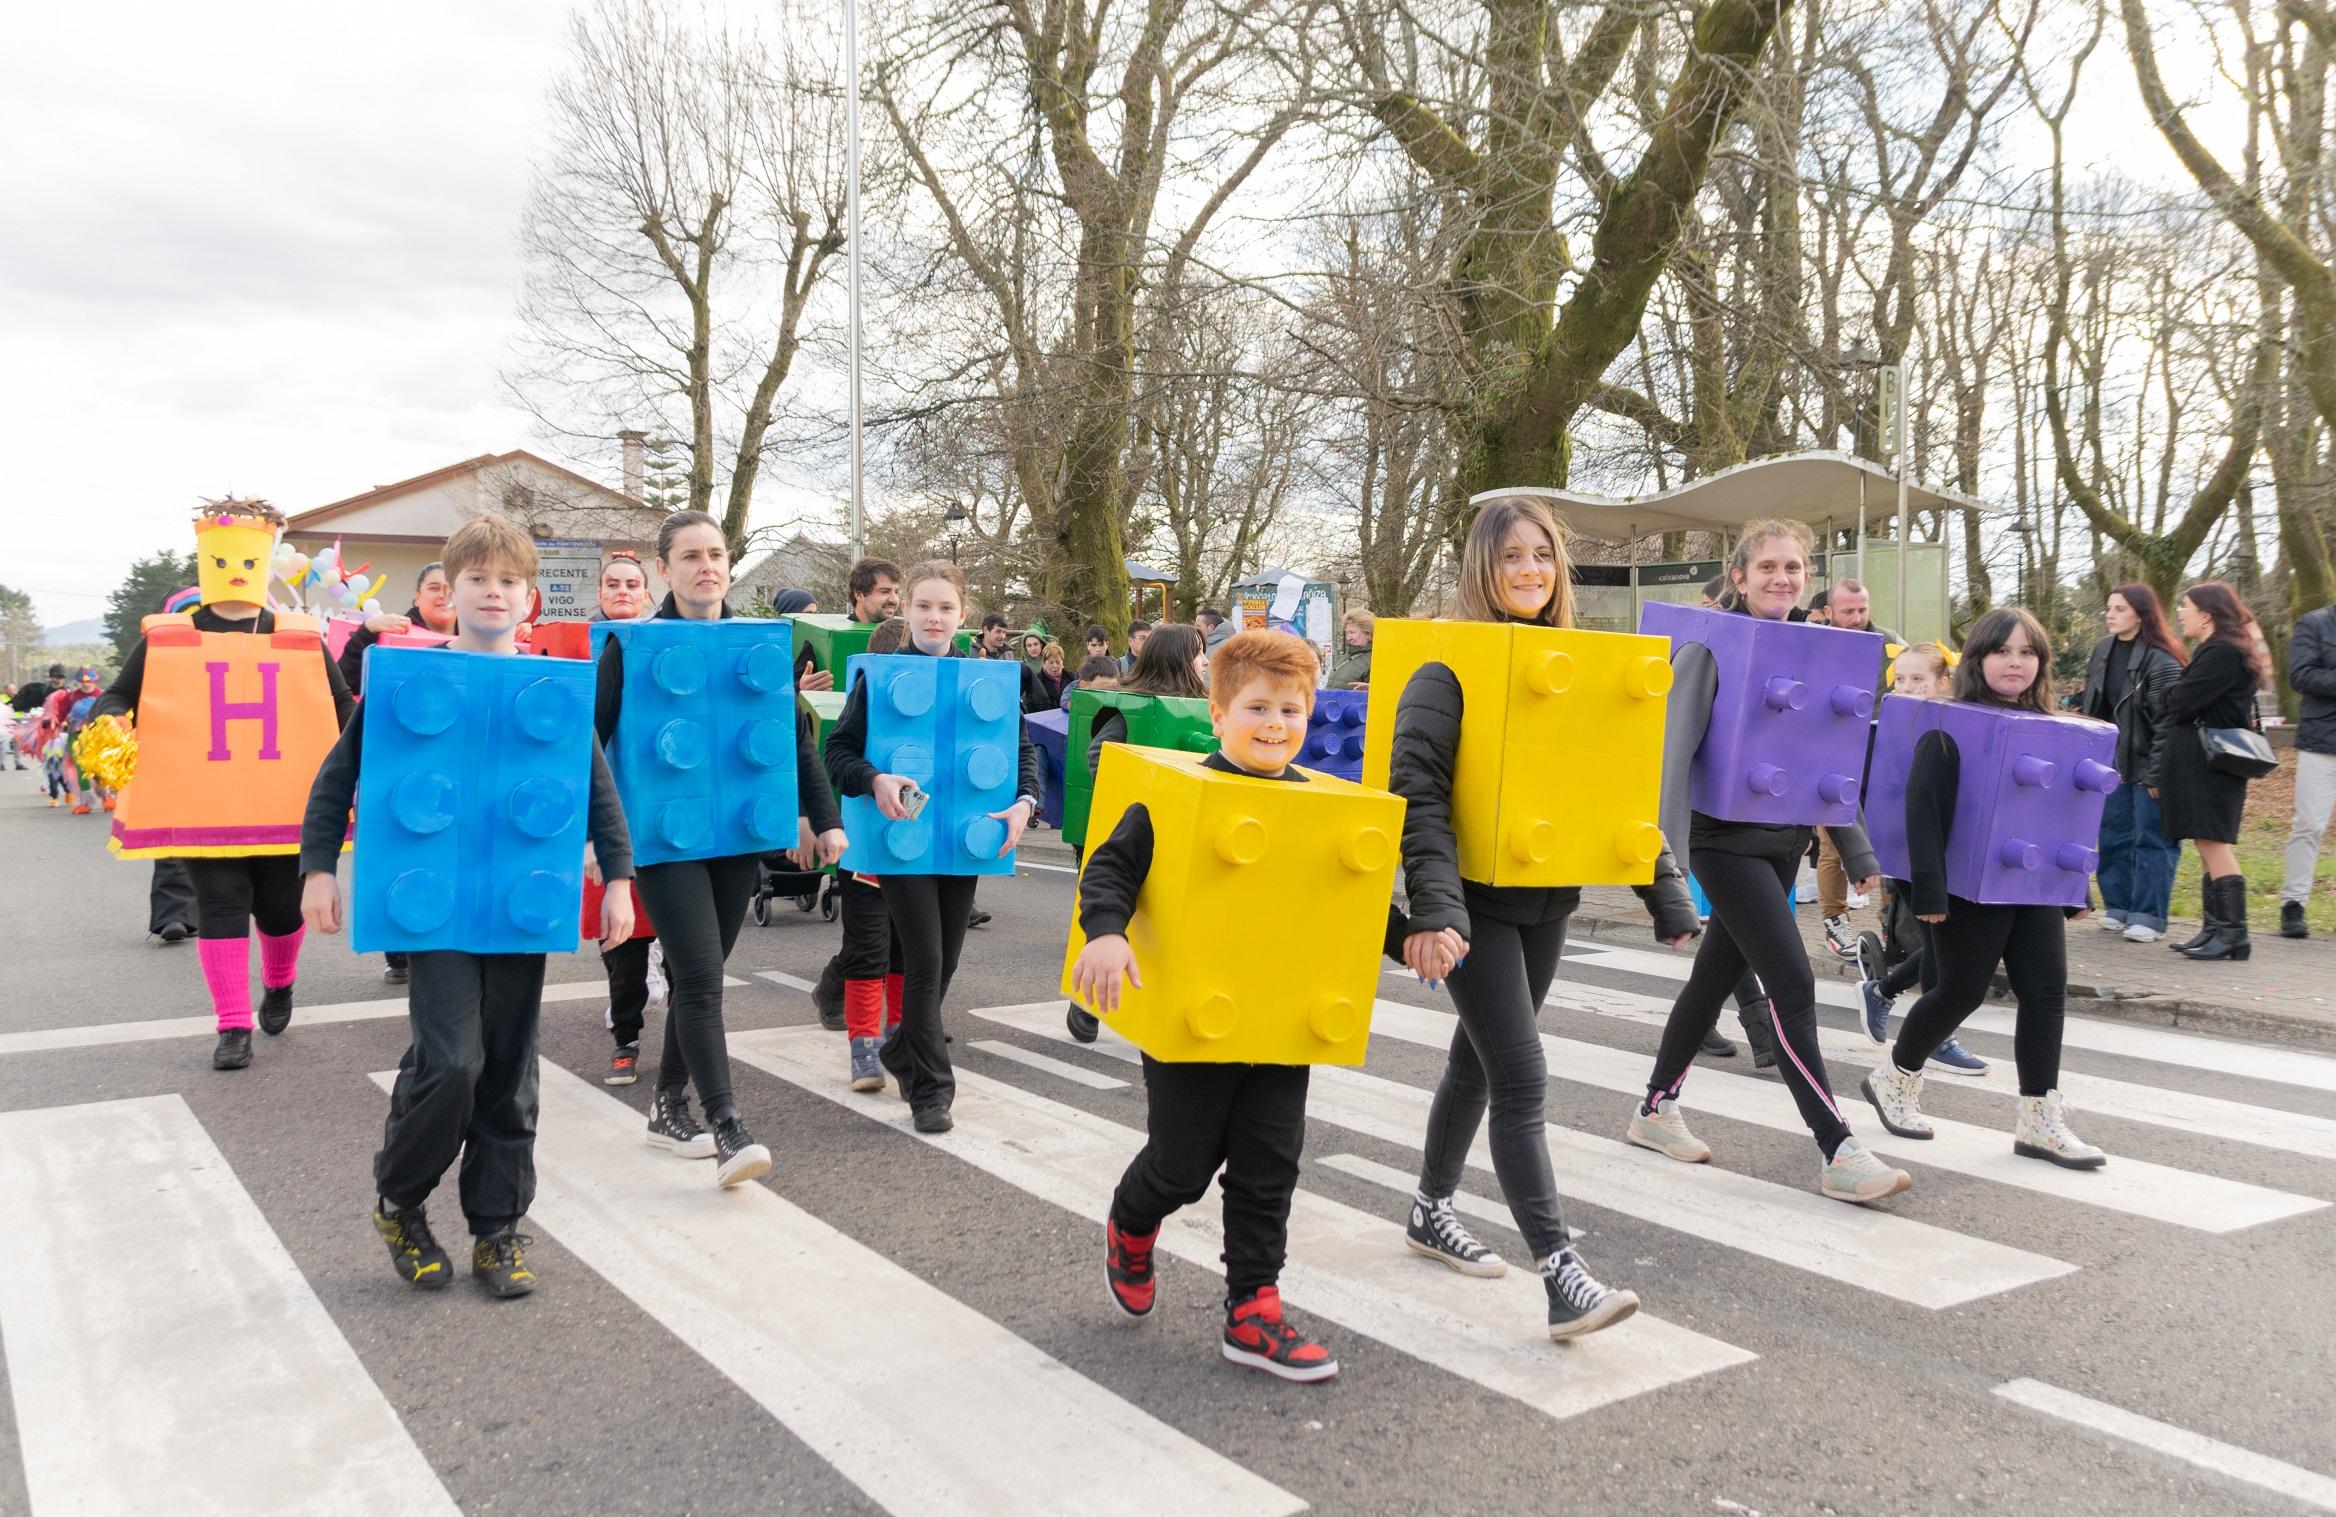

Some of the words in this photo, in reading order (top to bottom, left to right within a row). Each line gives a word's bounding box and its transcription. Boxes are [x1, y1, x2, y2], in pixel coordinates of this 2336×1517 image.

[539, 568, 588, 577] RECENTE
[549, 596, 574, 605] VIGO
[540, 608, 586, 617] URENSE
[205, 662, 281, 761] H
